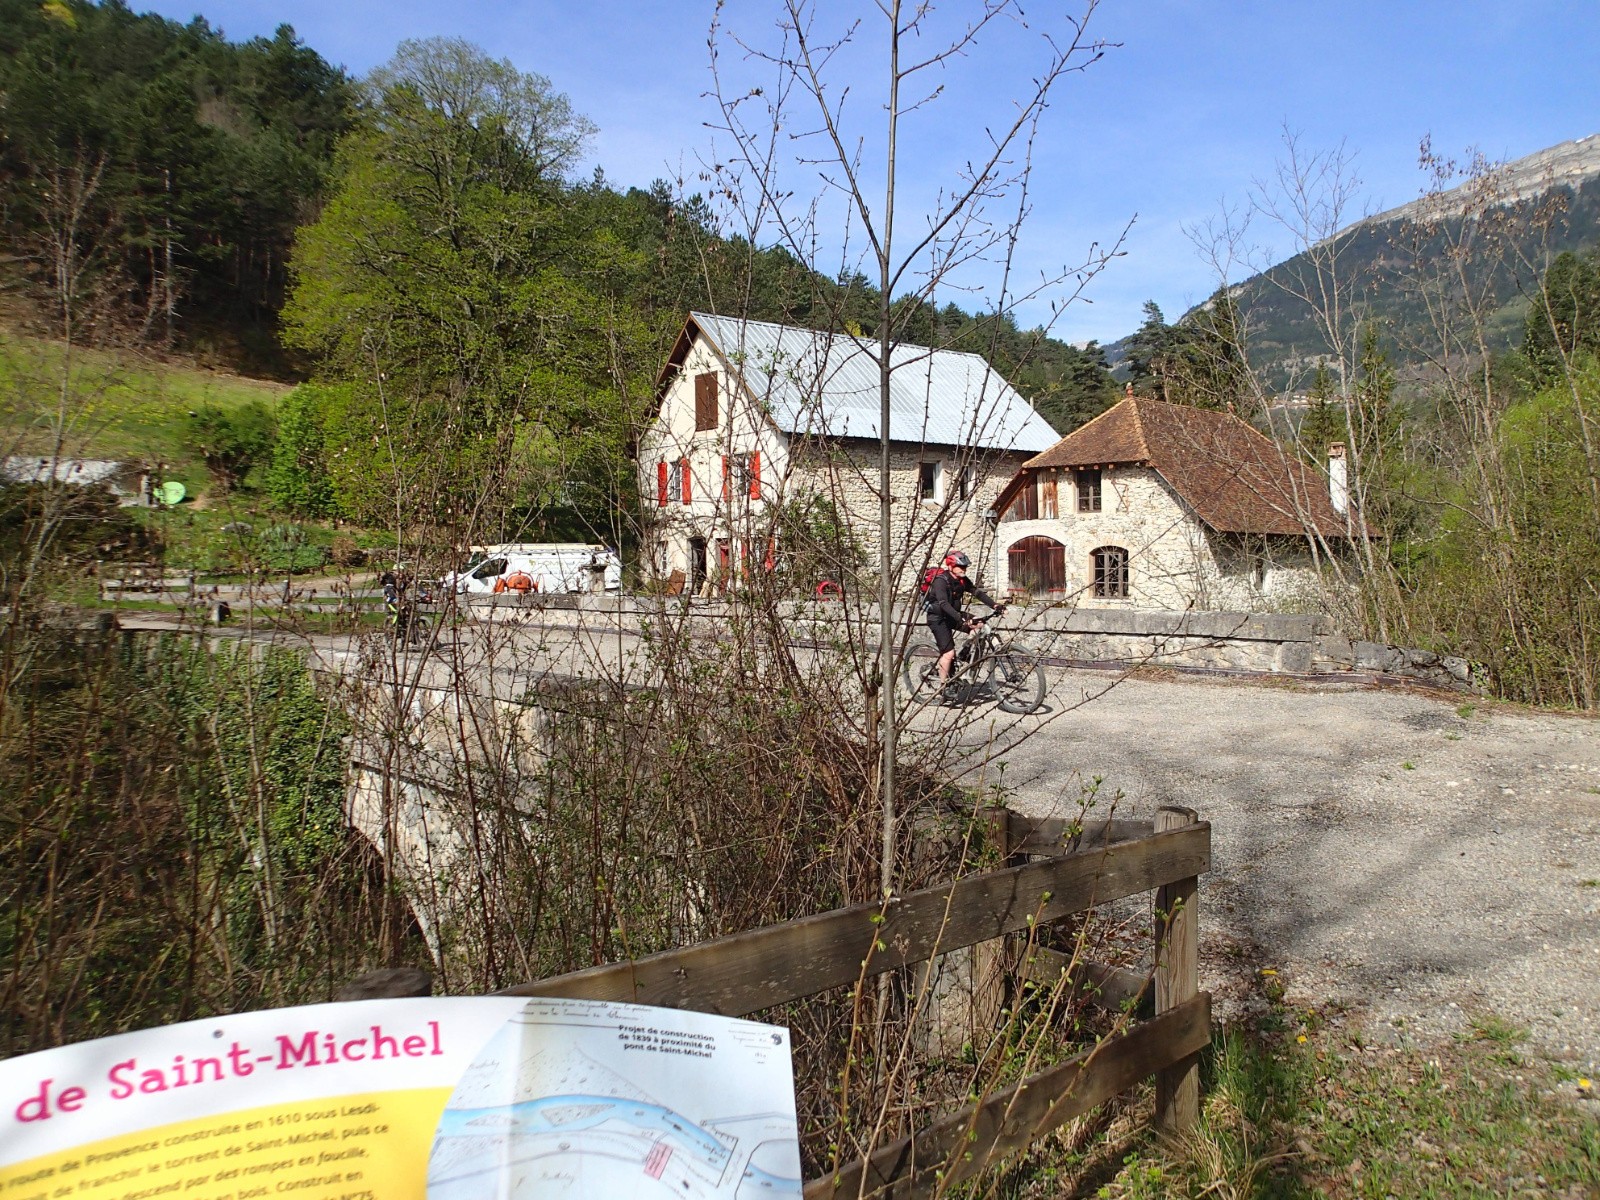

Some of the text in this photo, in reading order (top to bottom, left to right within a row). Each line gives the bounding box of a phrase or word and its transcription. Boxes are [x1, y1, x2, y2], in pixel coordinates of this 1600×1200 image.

[618, 1024, 714, 1042] Projet de construction
[618, 1033, 716, 1051] de 1839 à proximité du
[624, 1042, 713, 1059] pont de Saint-Michel
[16, 1021, 443, 1123] de Saint-Michel
[9, 1167, 56, 1187] route
[60, 1160, 81, 1174] de
[85, 1141, 160, 1166] Provence
[164, 1120, 241, 1148] construite
[245, 1119, 263, 1131] en
[268, 1112, 302, 1127] 1610
[305, 1109, 337, 1122] sous
[341, 1102, 380, 1117] Lesdi-
[78, 1168, 143, 1191] franchir
[147, 1163, 161, 1174] le
[165, 1148, 220, 1170] torrent
[223, 1144, 242, 1157] de
[246, 1127, 338, 1154] Saint-Michel,
[341, 1126, 370, 1140] puis
[374, 1124, 390, 1134] ce
[214, 1168, 239, 1182] des
[298, 1156, 315, 1167] en
[276, 1171, 343, 1193] Construit
[346, 1170, 364, 1182] en
